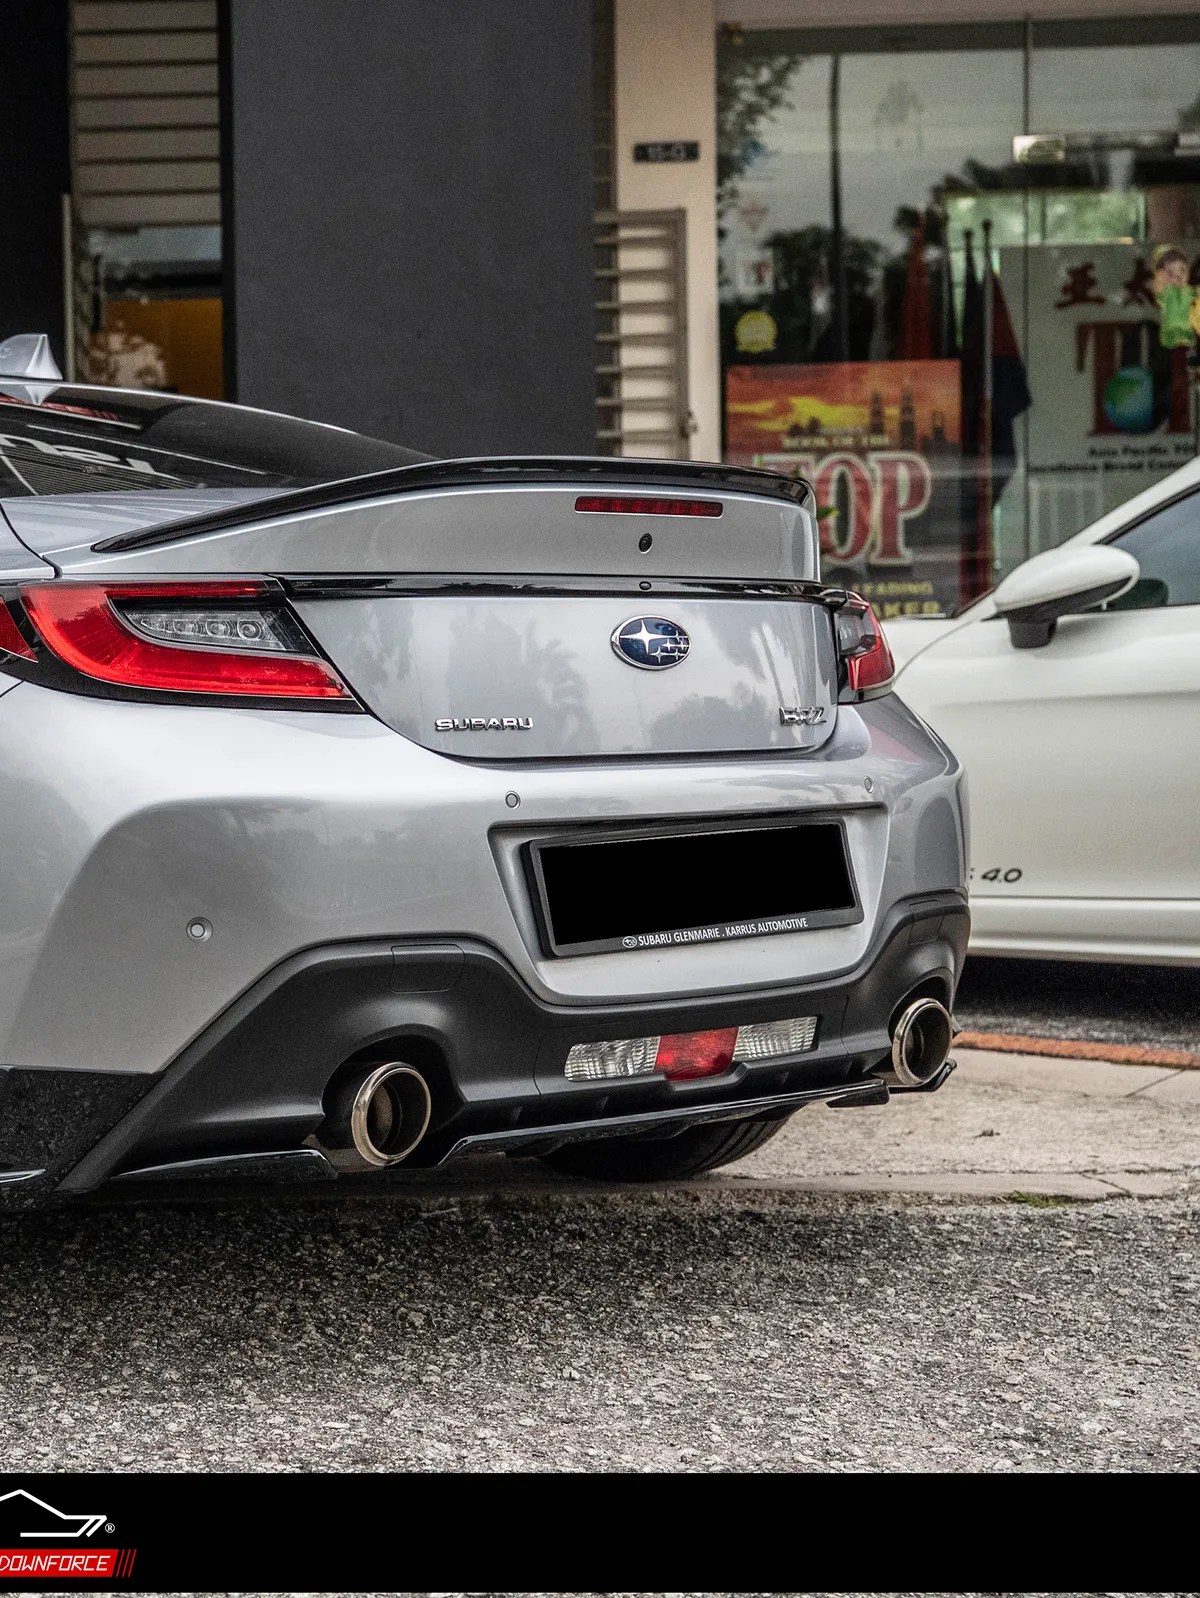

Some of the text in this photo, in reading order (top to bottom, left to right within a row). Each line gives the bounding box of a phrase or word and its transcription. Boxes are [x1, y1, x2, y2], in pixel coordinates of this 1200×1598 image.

[435, 716, 534, 732] SUBARU
[779, 706, 826, 726] BRZ
[981, 868, 1022, 883] 4.0
[638, 932, 673, 946] SUBARU
[673, 927, 720, 942] GLENMARIE
[725, 923, 757, 937] KARRUS
[758, 917, 809, 933] AUTOMOTIVE
